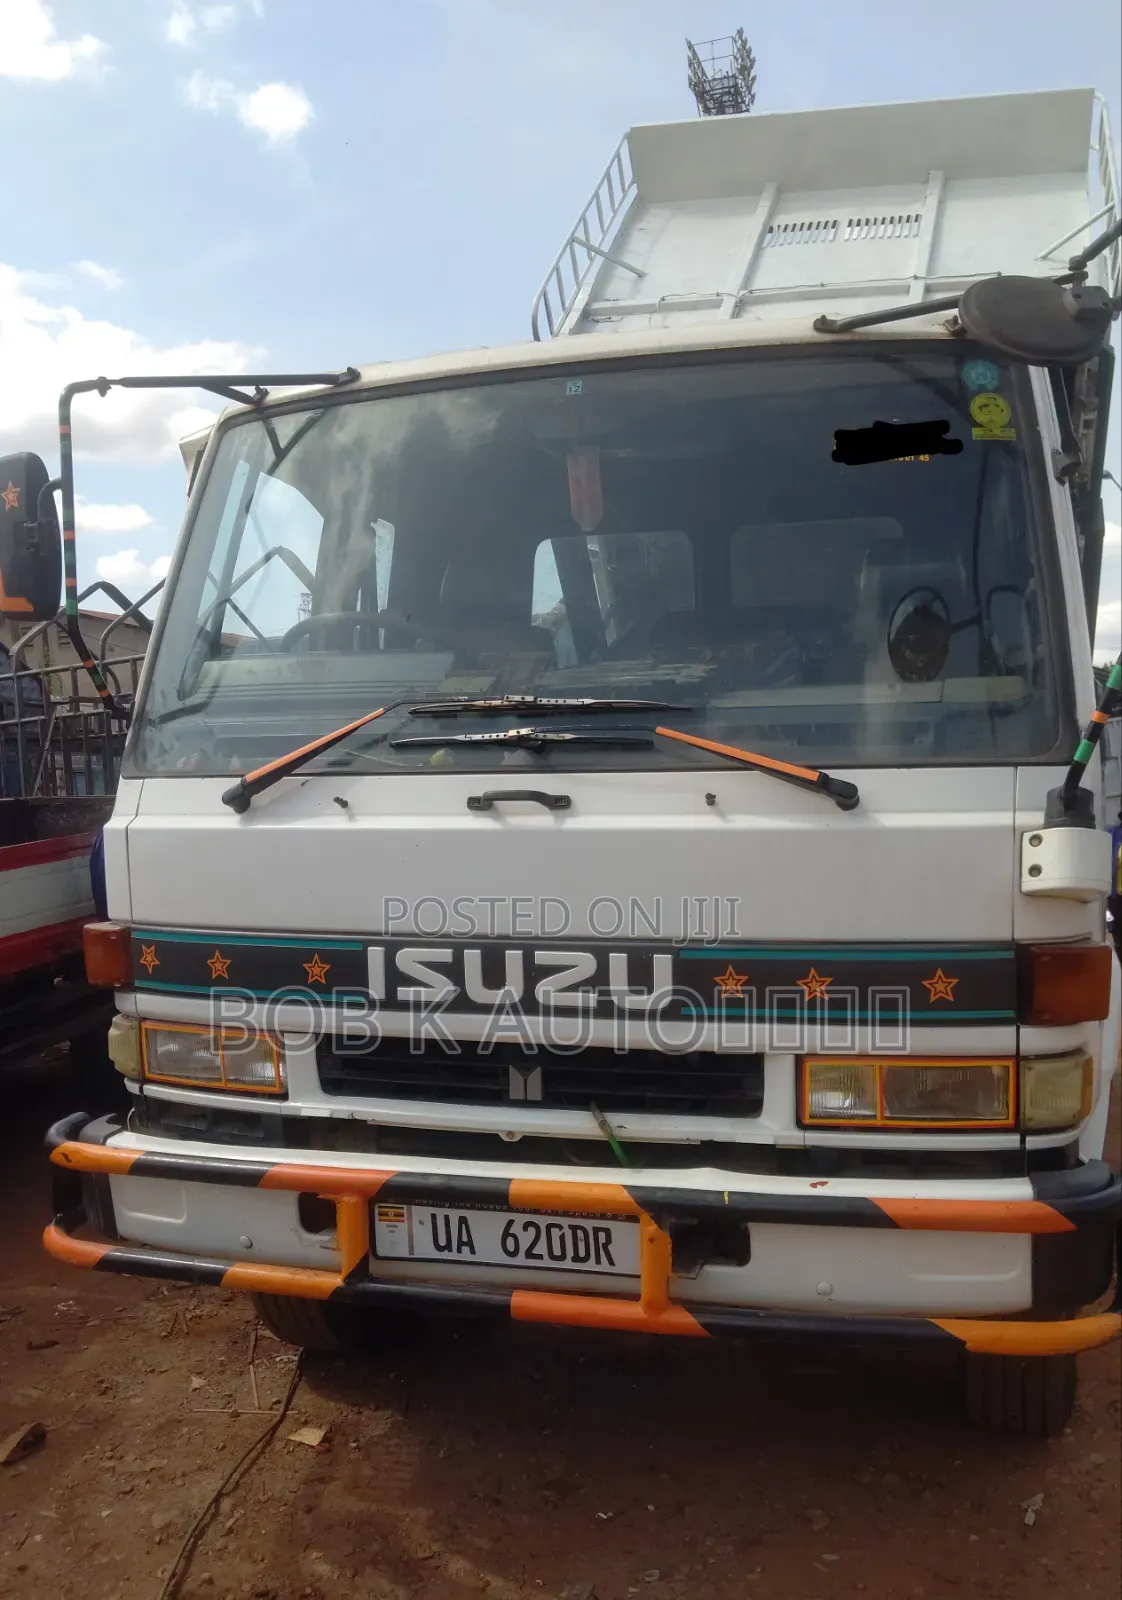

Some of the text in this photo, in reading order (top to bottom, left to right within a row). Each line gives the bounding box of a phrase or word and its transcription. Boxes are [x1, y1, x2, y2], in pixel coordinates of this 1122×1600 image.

[568, 385, 581, 394] 12
[368, 946, 673, 1009] ISUZU
[431, 1213, 616, 1266] UA 620DR
